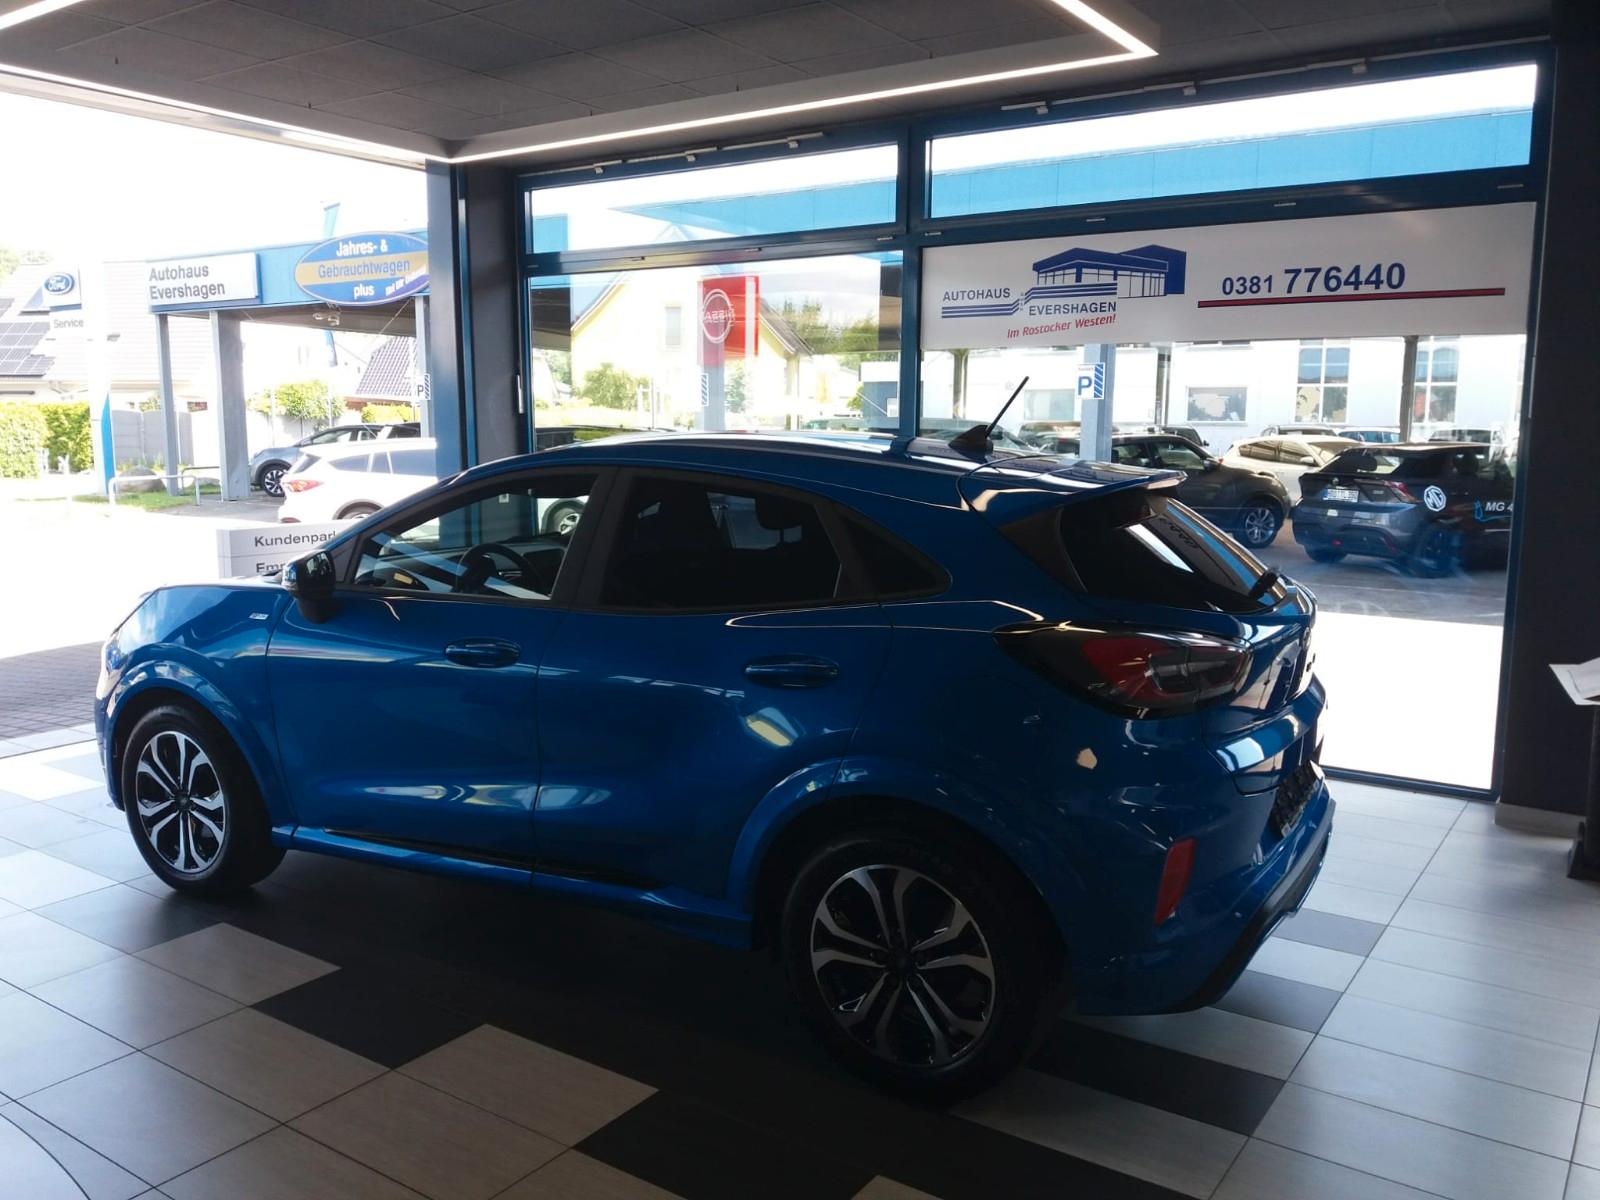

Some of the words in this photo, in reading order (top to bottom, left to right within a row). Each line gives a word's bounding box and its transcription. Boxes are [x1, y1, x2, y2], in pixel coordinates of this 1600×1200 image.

[335, 239, 377, 257] Jahres-
[380, 238, 388, 253] &
[148, 264, 209, 282] Autohaus
[317, 259, 411, 279] Gebrauchtwagen
[1221, 274, 1274, 296] 0381
[1284, 262, 1406, 294] 776440
[148, 282, 226, 300] Evershagen
[353, 283, 375, 299] plus
[942, 287, 1011, 302] AUTOHAUS
[1028, 301, 1117, 316] EVERSHAGEN
[53, 319, 84, 329] Service
[1007, 328, 1020, 339] Im
[1022, 321, 1072, 337] Rostocker
[1075, 313, 1117, 329] Westen!
[416, 384, 424, 398] P
[1077, 375, 1093, 396] P
[1484, 501, 1506, 512] MG
